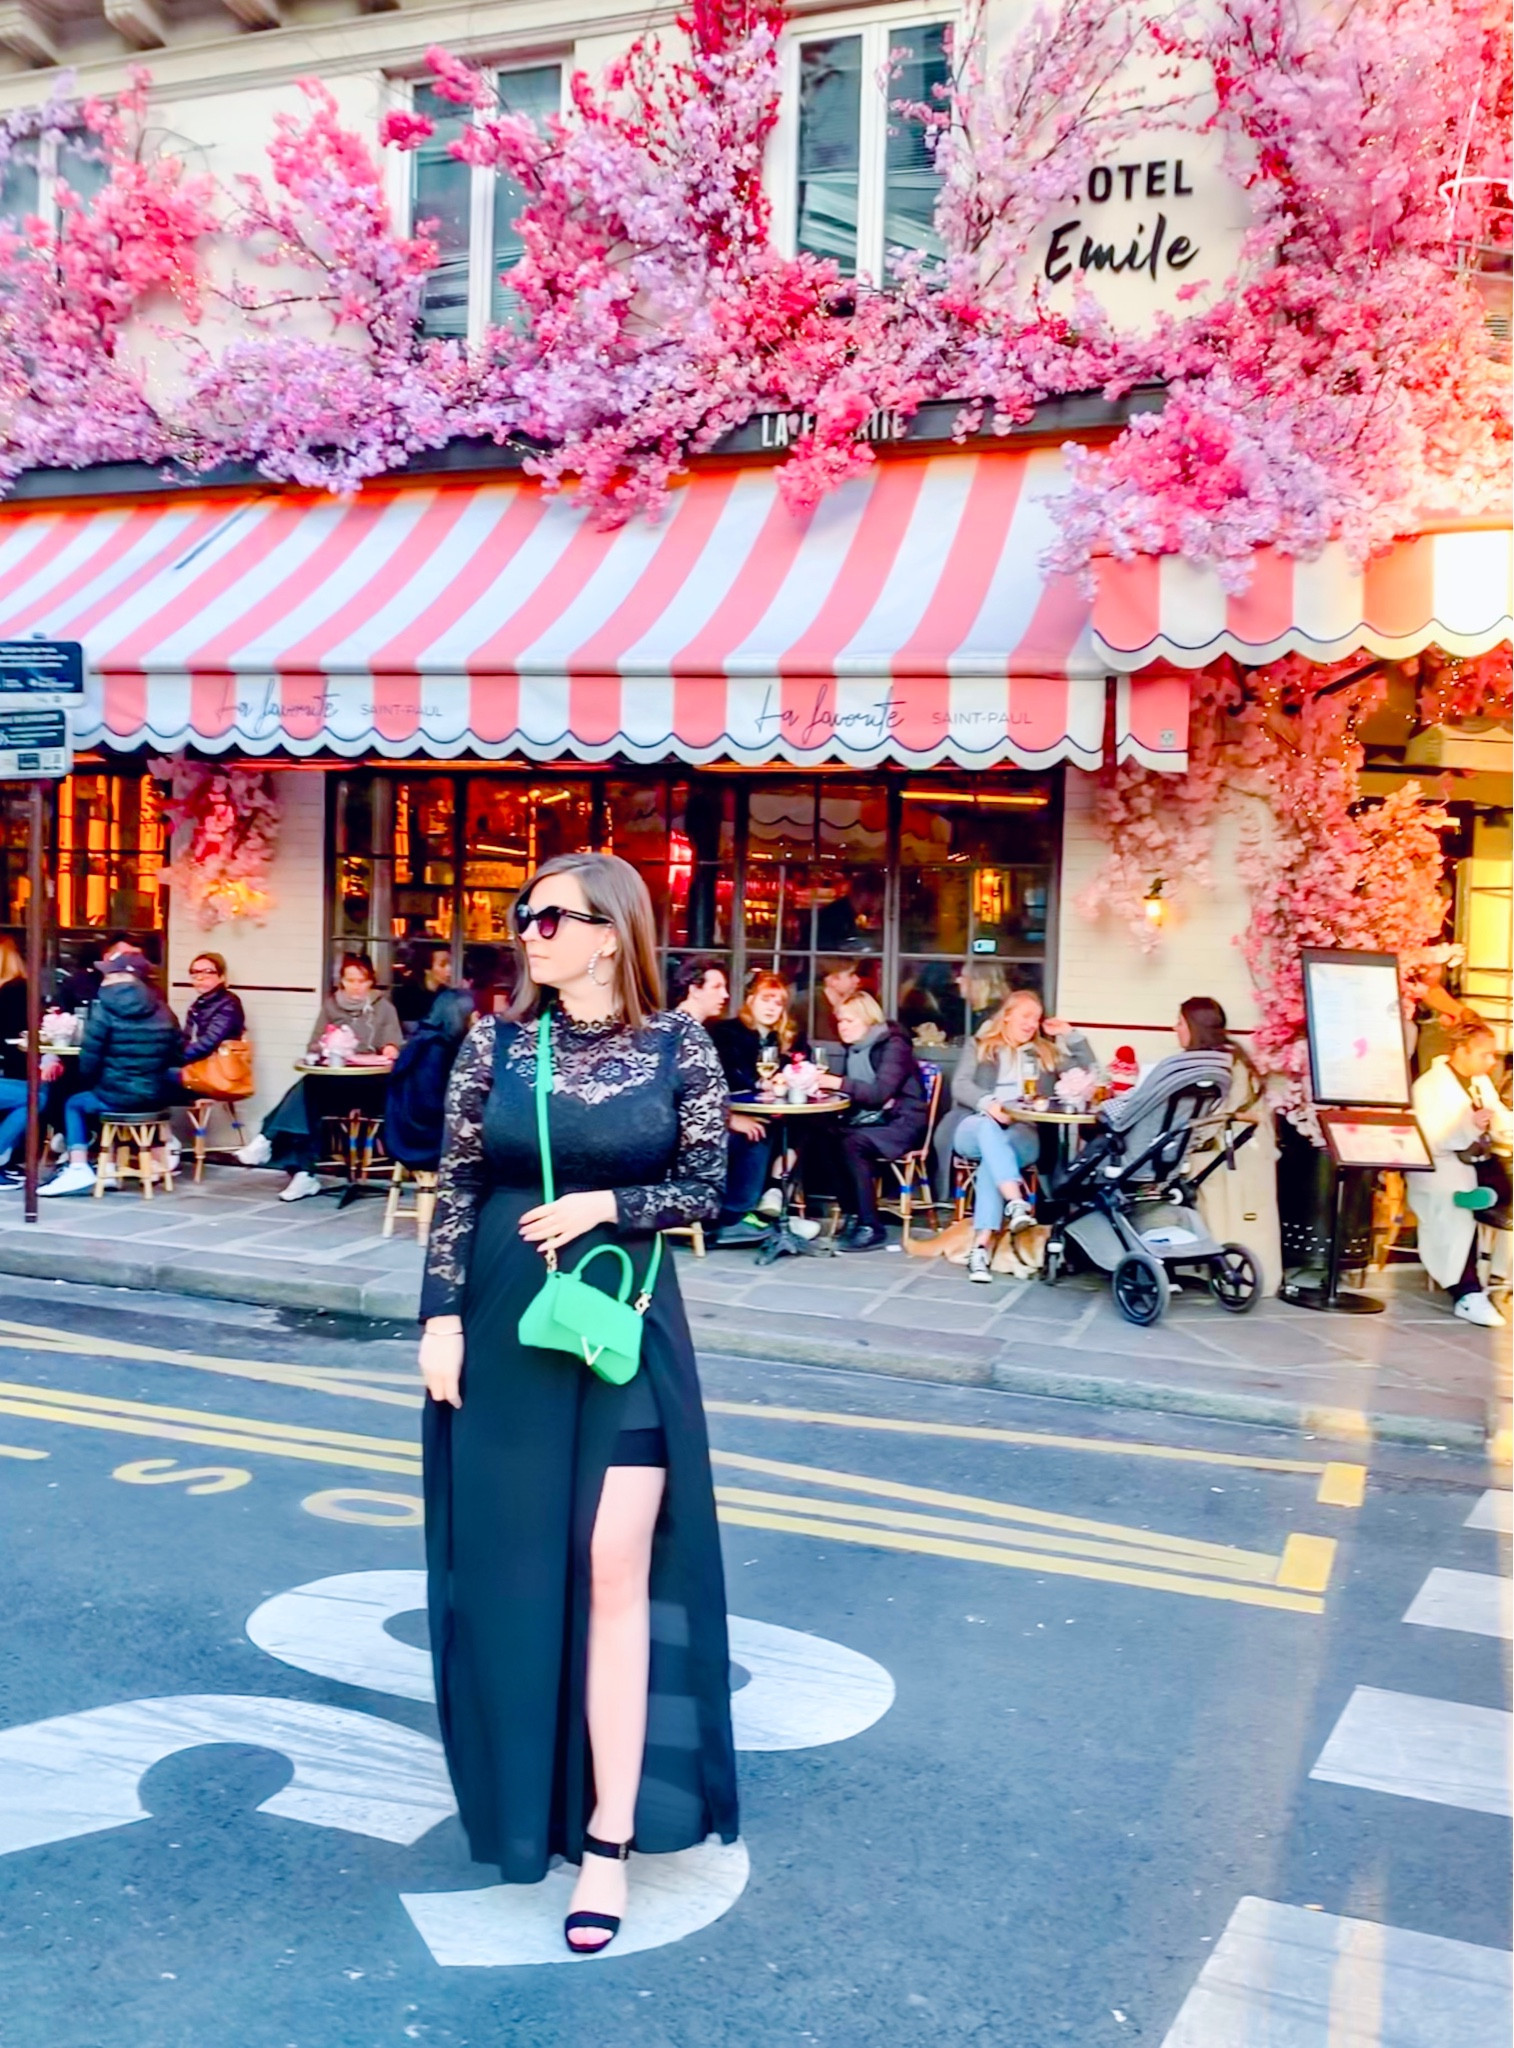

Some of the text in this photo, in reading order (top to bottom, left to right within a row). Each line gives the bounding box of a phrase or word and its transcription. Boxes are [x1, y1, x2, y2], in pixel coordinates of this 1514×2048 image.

[1073, 158, 1194, 204] OTEL
[1043, 211, 1201, 285] Emile
[761, 412, 789, 448] LA
[360, 703, 443, 717] SAINT-PAUL
[754, 683, 800, 734] La
[931, 711, 1033, 725] SAINT-PAUL
